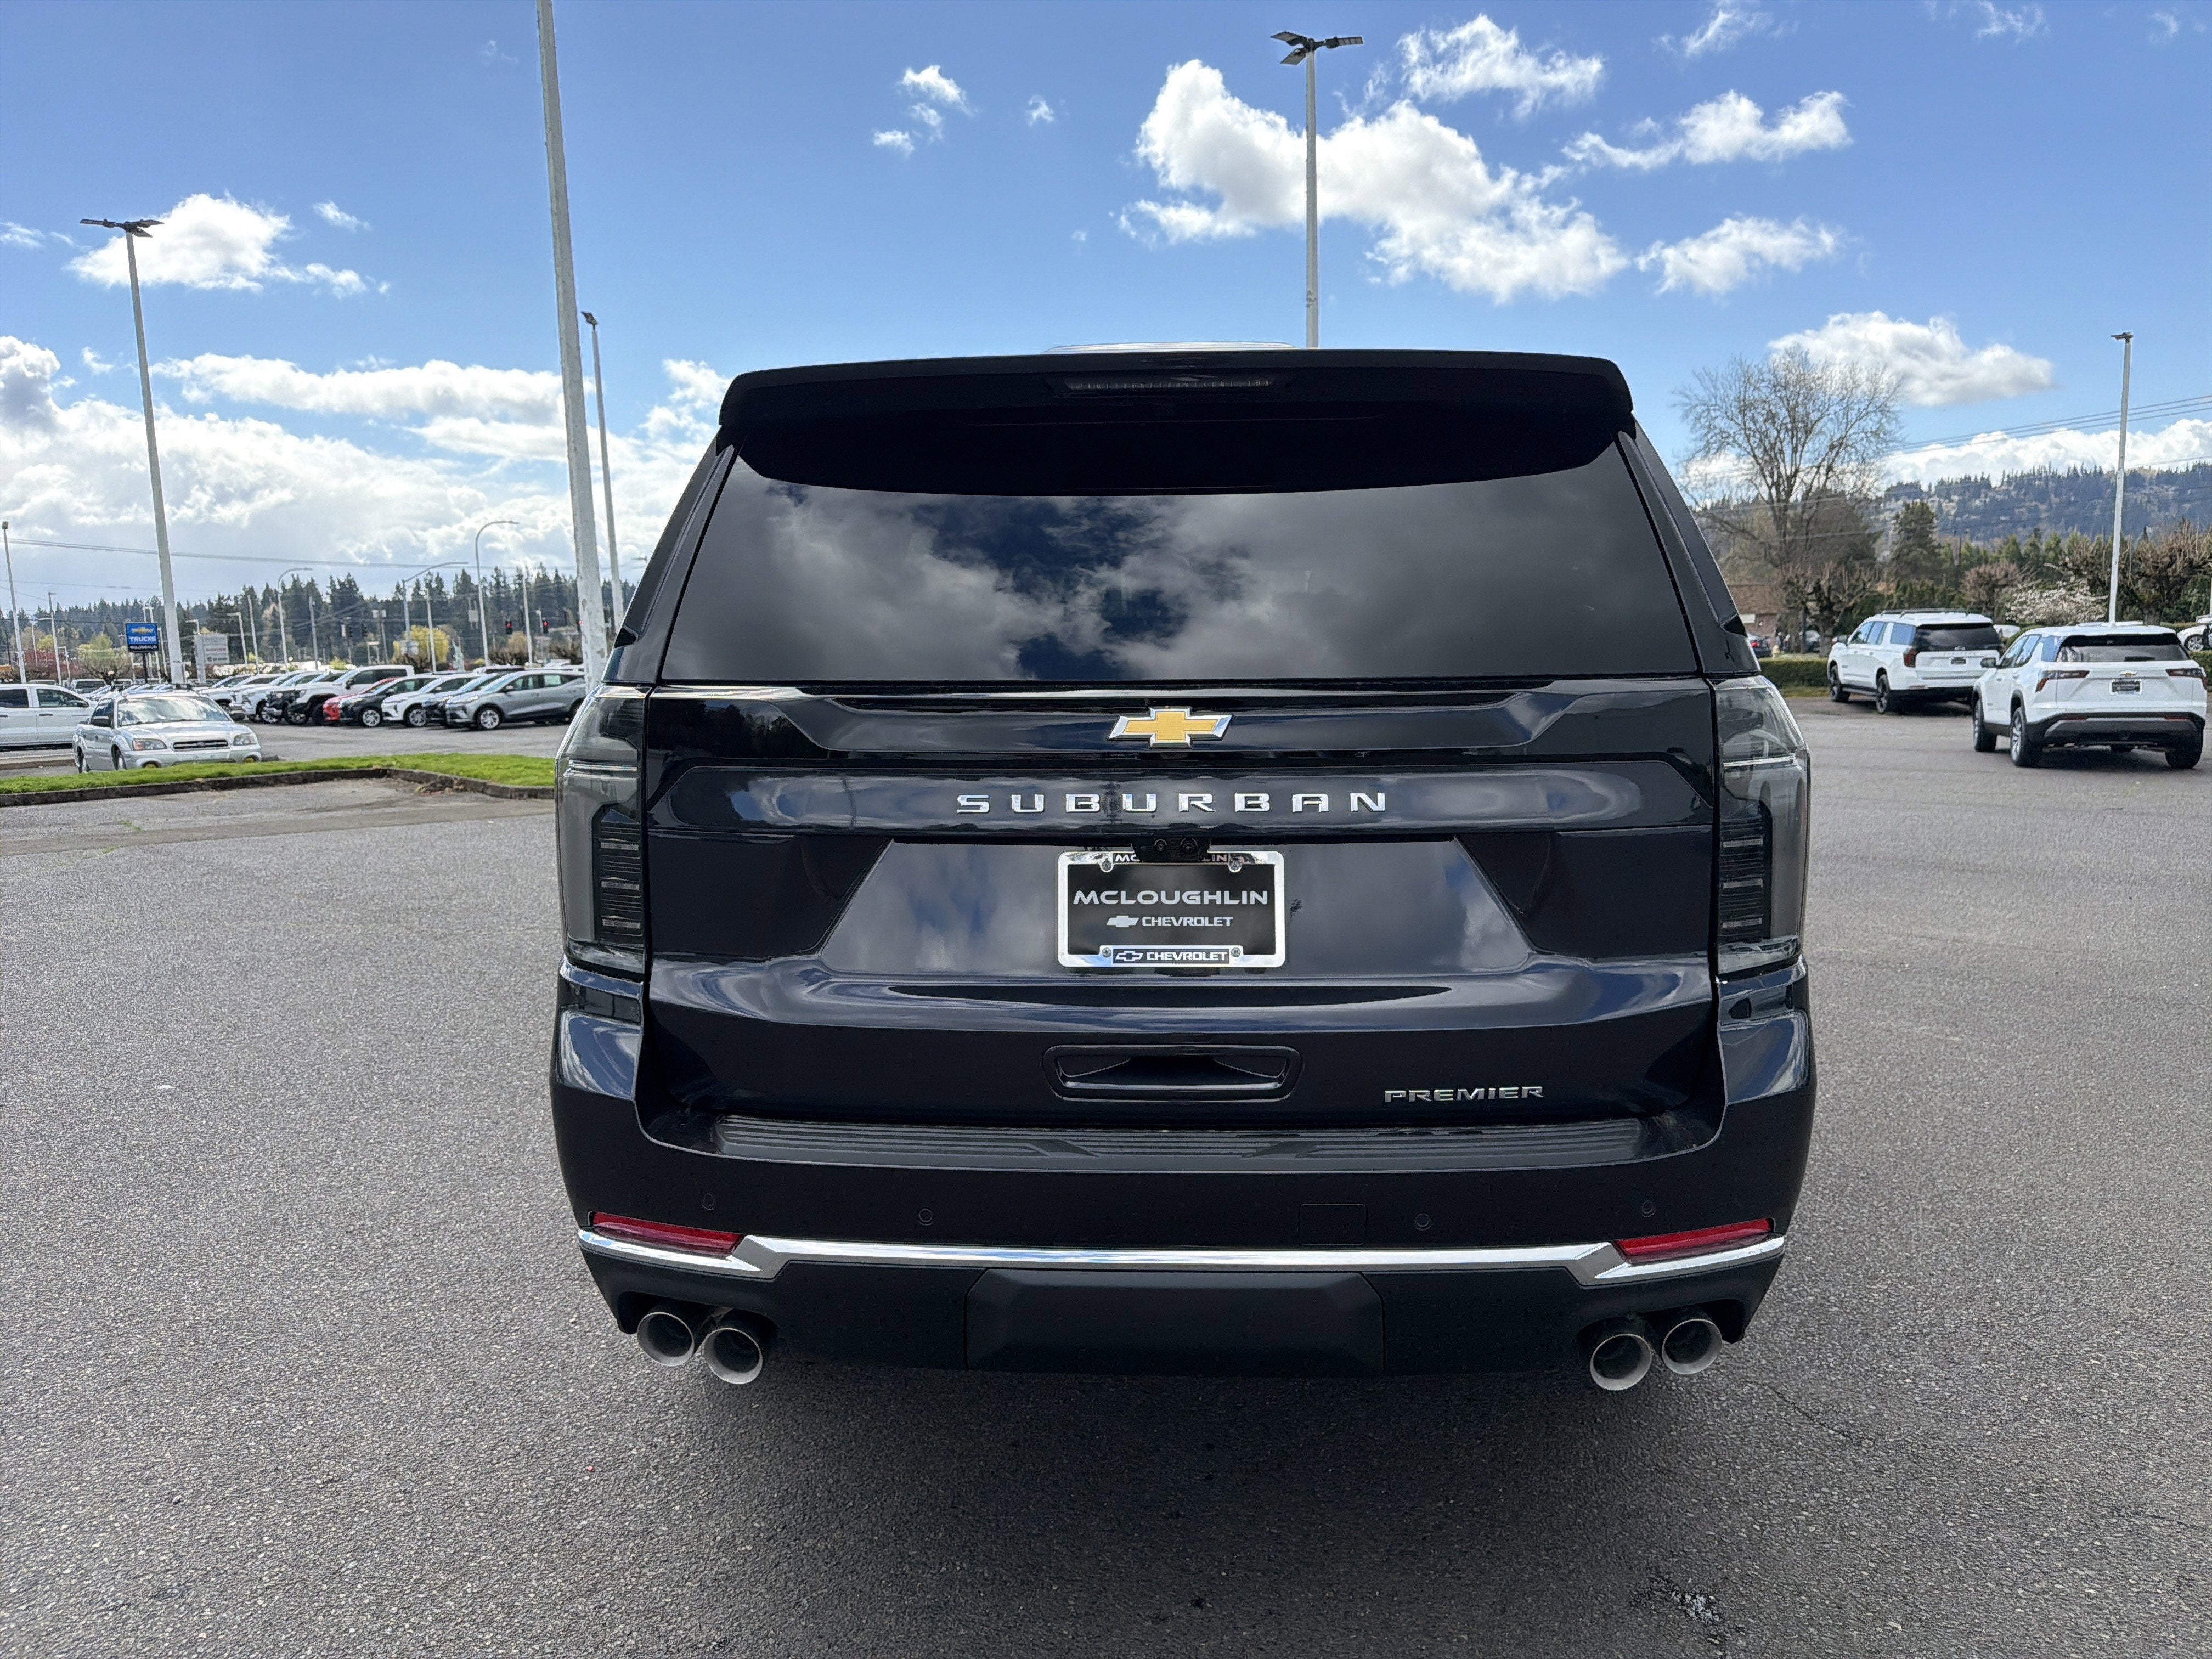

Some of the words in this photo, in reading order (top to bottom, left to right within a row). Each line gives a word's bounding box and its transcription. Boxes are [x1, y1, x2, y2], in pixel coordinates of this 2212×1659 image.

[956, 793, 1385, 813] SUBURBAN
[1073, 890, 1268, 905] MCLOUGHLIN
[1142, 917, 1233, 927] CHEVROLET
[1147, 952, 1228, 961] CHEVROLET
[1384, 1086, 1544, 1102] PREMIER
